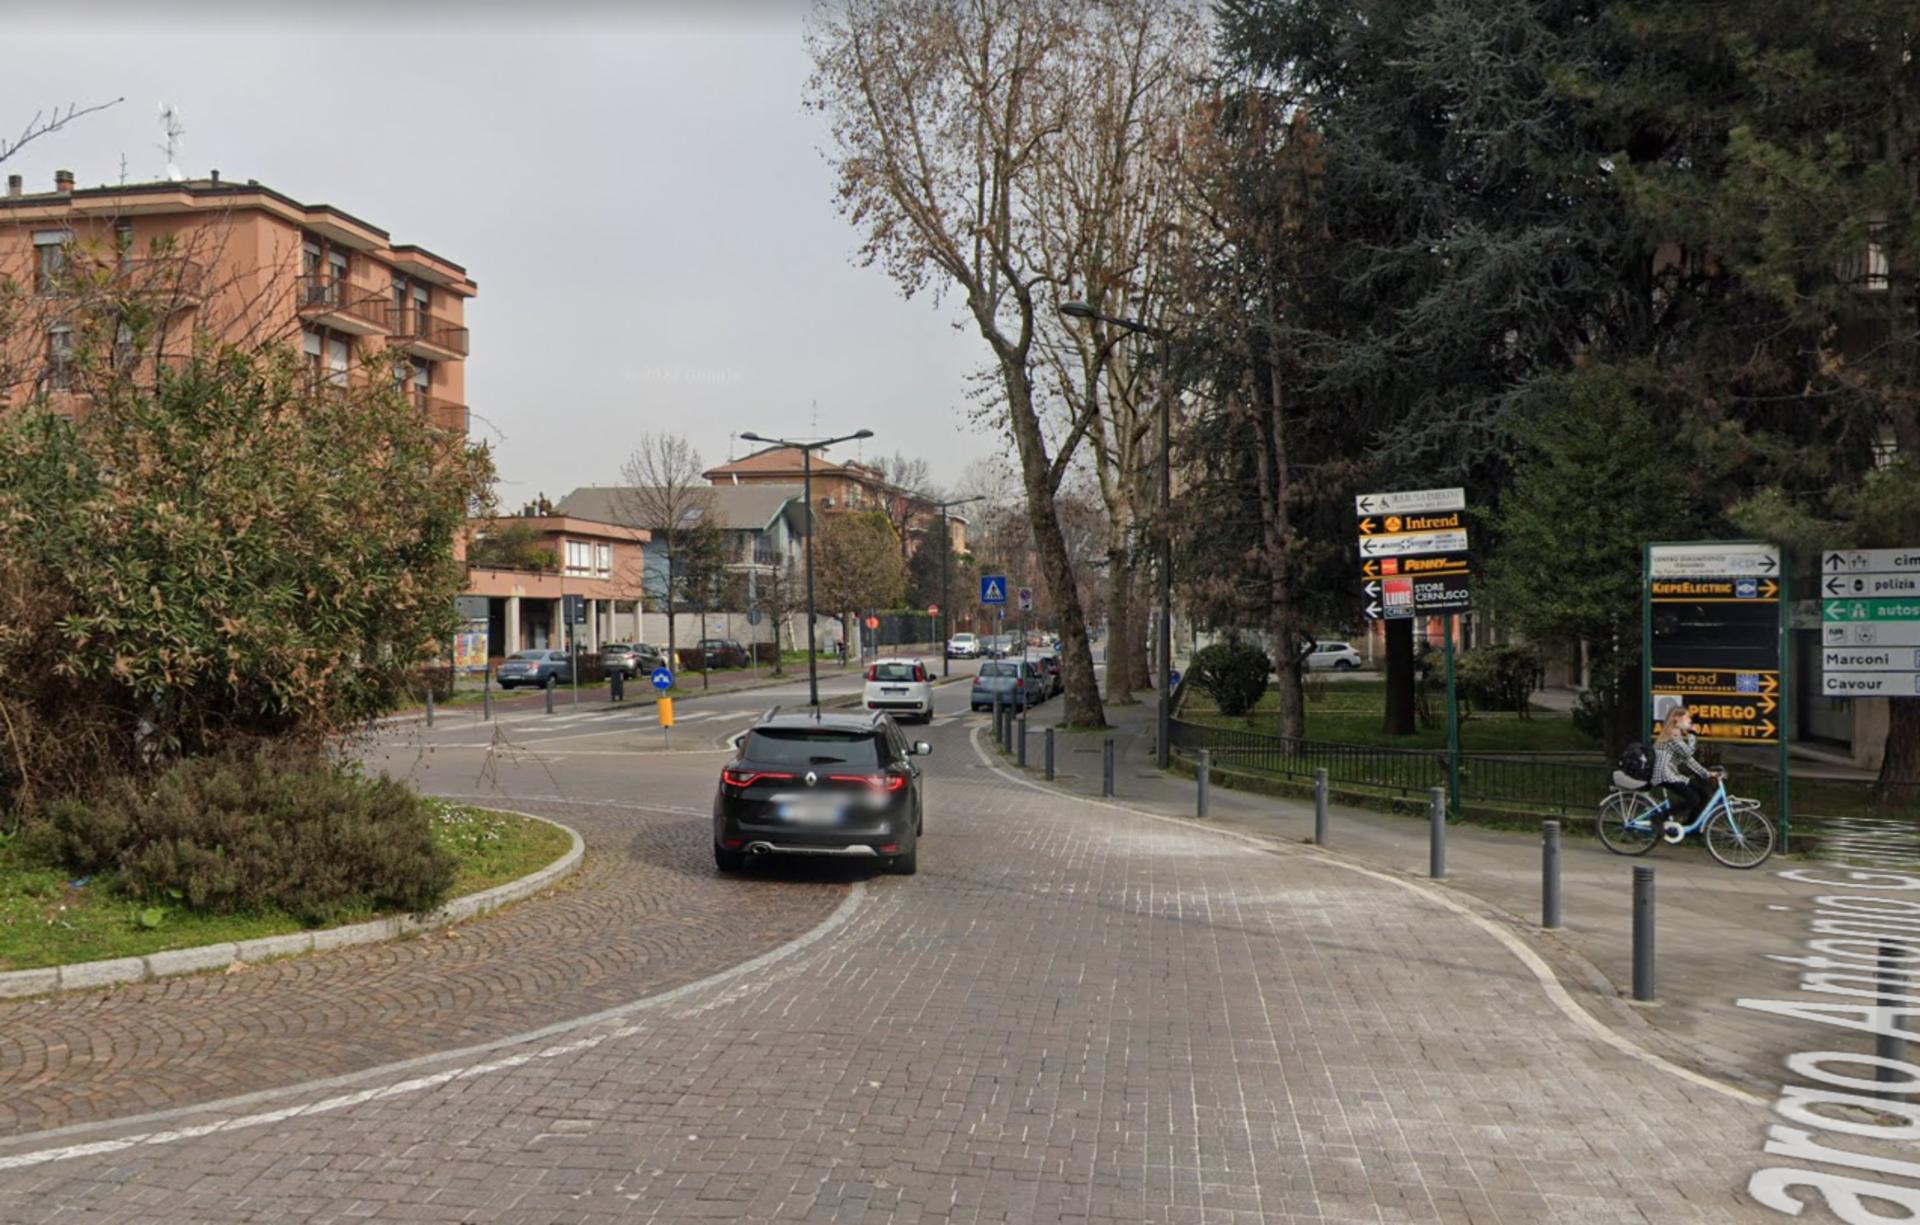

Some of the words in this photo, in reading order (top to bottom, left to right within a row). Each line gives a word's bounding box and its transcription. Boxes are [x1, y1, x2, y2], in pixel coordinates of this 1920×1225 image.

[1405, 513, 1459, 530] Intrend
[1404, 558, 1448, 571] PENNY
[1415, 583, 1445, 592] STORE
[1875, 579, 1916, 592] polizia
[1415, 589, 1468, 602] CERNUSCO
[1827, 653, 1889, 665] Marconi
[1676, 672, 1717, 685] bead
[1826, 678, 1883, 690] Cavour
[1688, 704, 1756, 720] PEREGO
